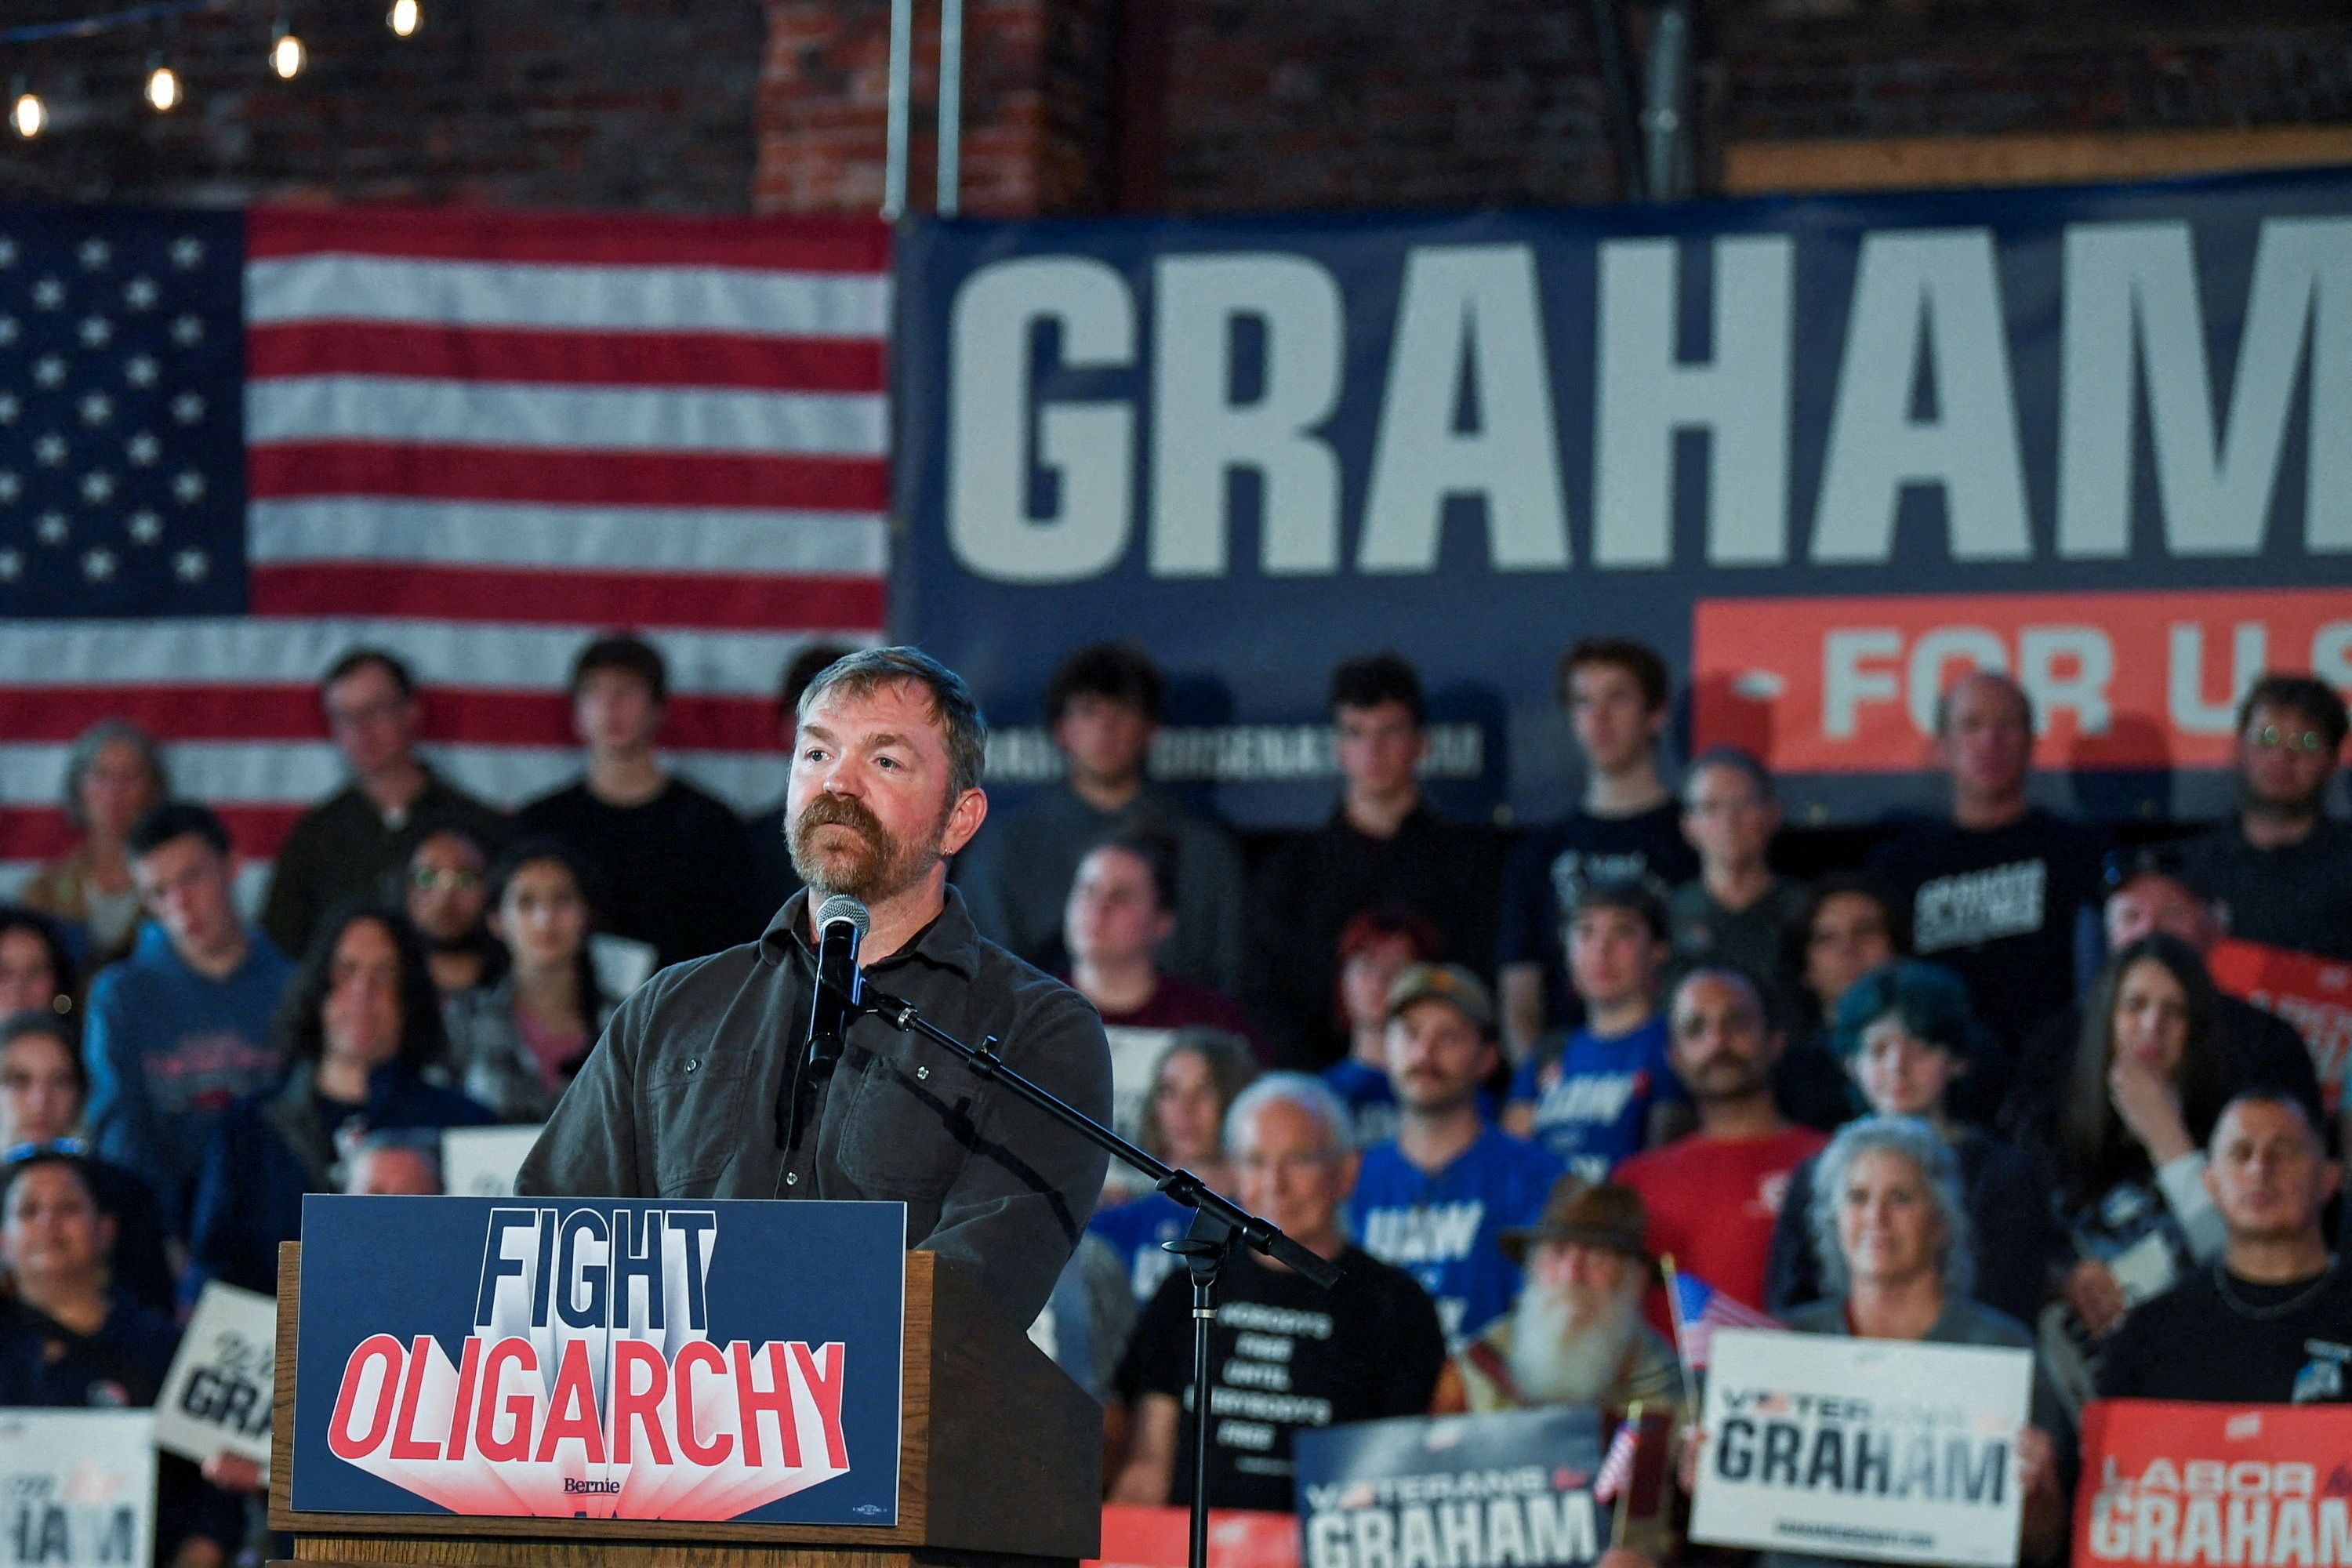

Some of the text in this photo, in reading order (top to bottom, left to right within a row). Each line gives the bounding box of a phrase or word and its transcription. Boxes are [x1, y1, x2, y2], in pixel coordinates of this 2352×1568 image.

[947, 218, 2352, 581] GRAHAM
[1824, 625, 2113, 738] FOR
[474, 1208, 716, 1330] FIGHT
[327, 1334, 849, 1469] OLIGARCHY
[564, 1478, 620, 1494] Bernie
[1307, 1466, 1548, 1509] VTERANS
[1719, 1417, 2007, 1504] GRAHAM
[2103, 1456, 2315, 1497] LABOR
[1307, 1492, 1597, 1568] GRAHAM
